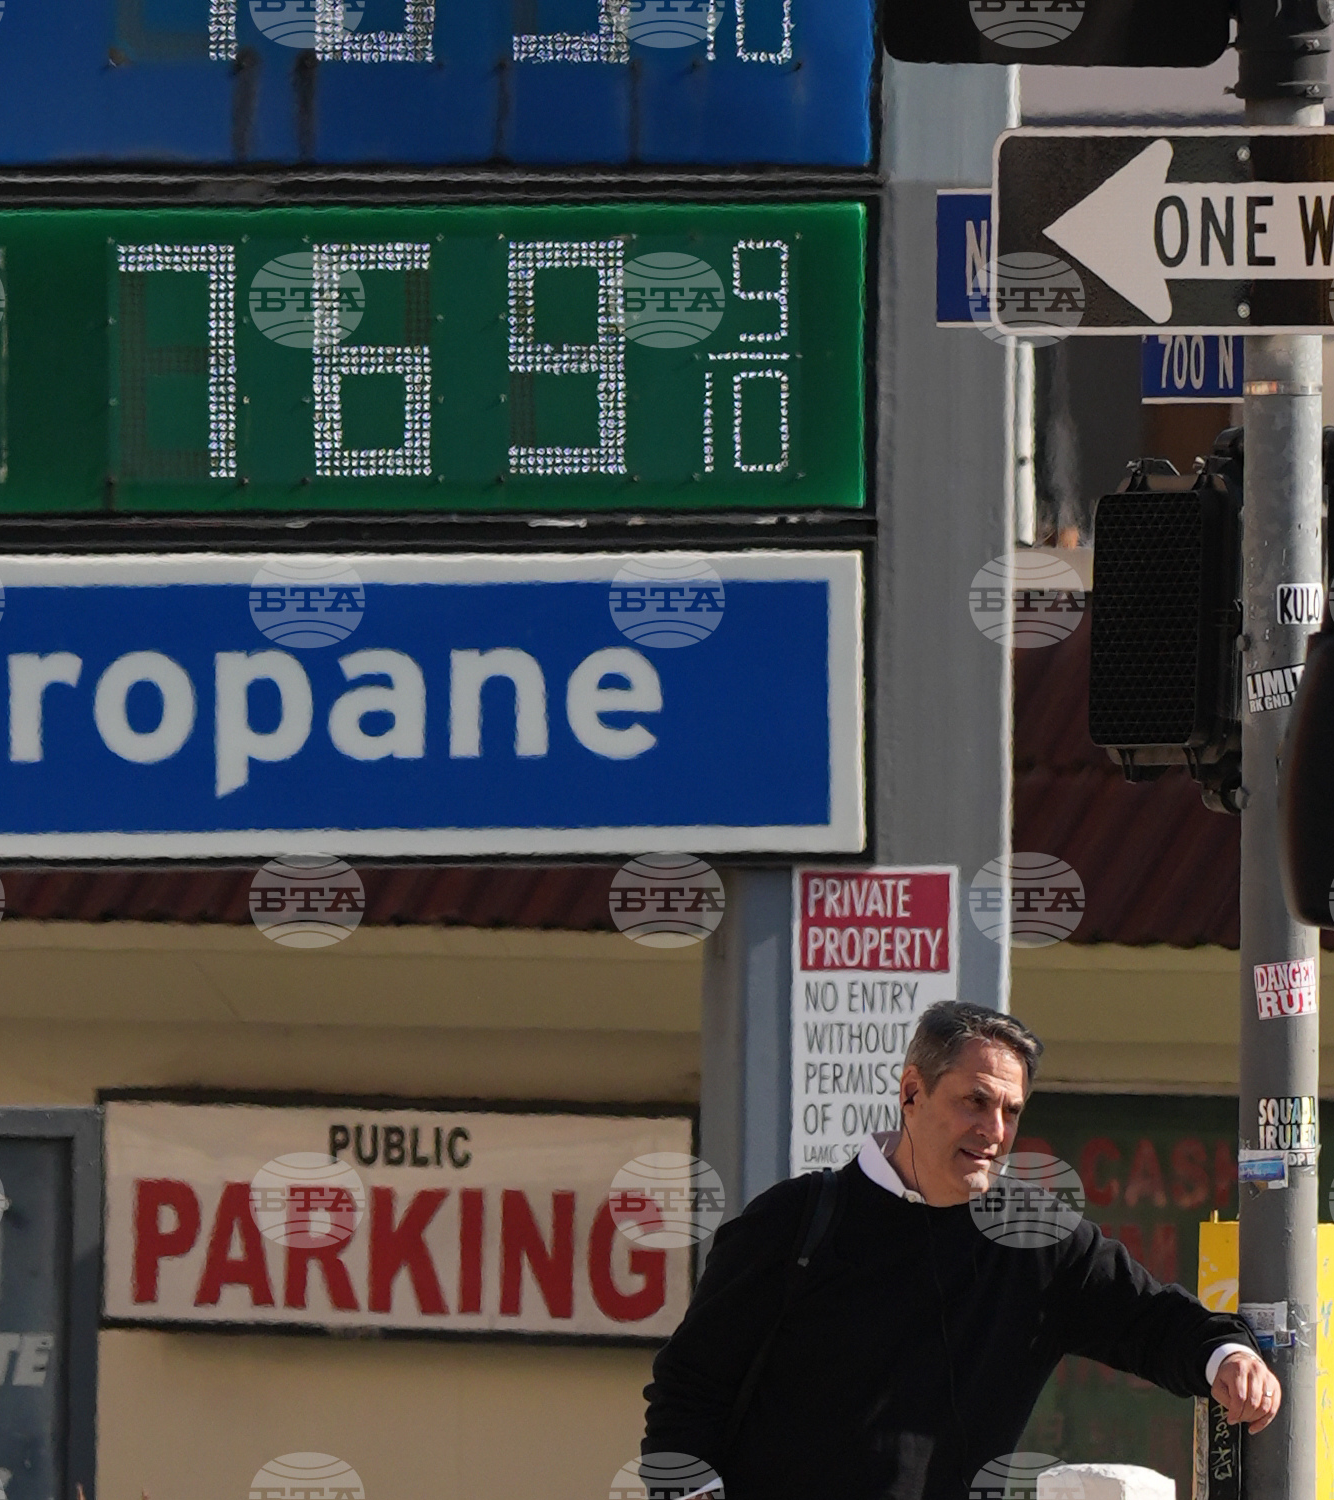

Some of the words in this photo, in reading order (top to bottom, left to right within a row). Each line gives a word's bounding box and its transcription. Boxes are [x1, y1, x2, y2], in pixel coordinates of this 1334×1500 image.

[1153, 194, 1277, 269] ONE
[965, 219, 988, 297] N
[1157, 336, 1205, 390] 700
[1218, 336, 1234, 390] N
[806, 878, 912, 919] PRIVATE
[806, 926, 944, 969] PROPERTY
[804, 980, 839, 1012] NO
[848, 981, 919, 1014] ENTRY
[804, 1022, 909, 1055] WITHOUT
[803, 1103, 832, 1135] OF
[329, 1123, 472, 1168] PUBLIC
[131, 1177, 667, 1322] PARKING
